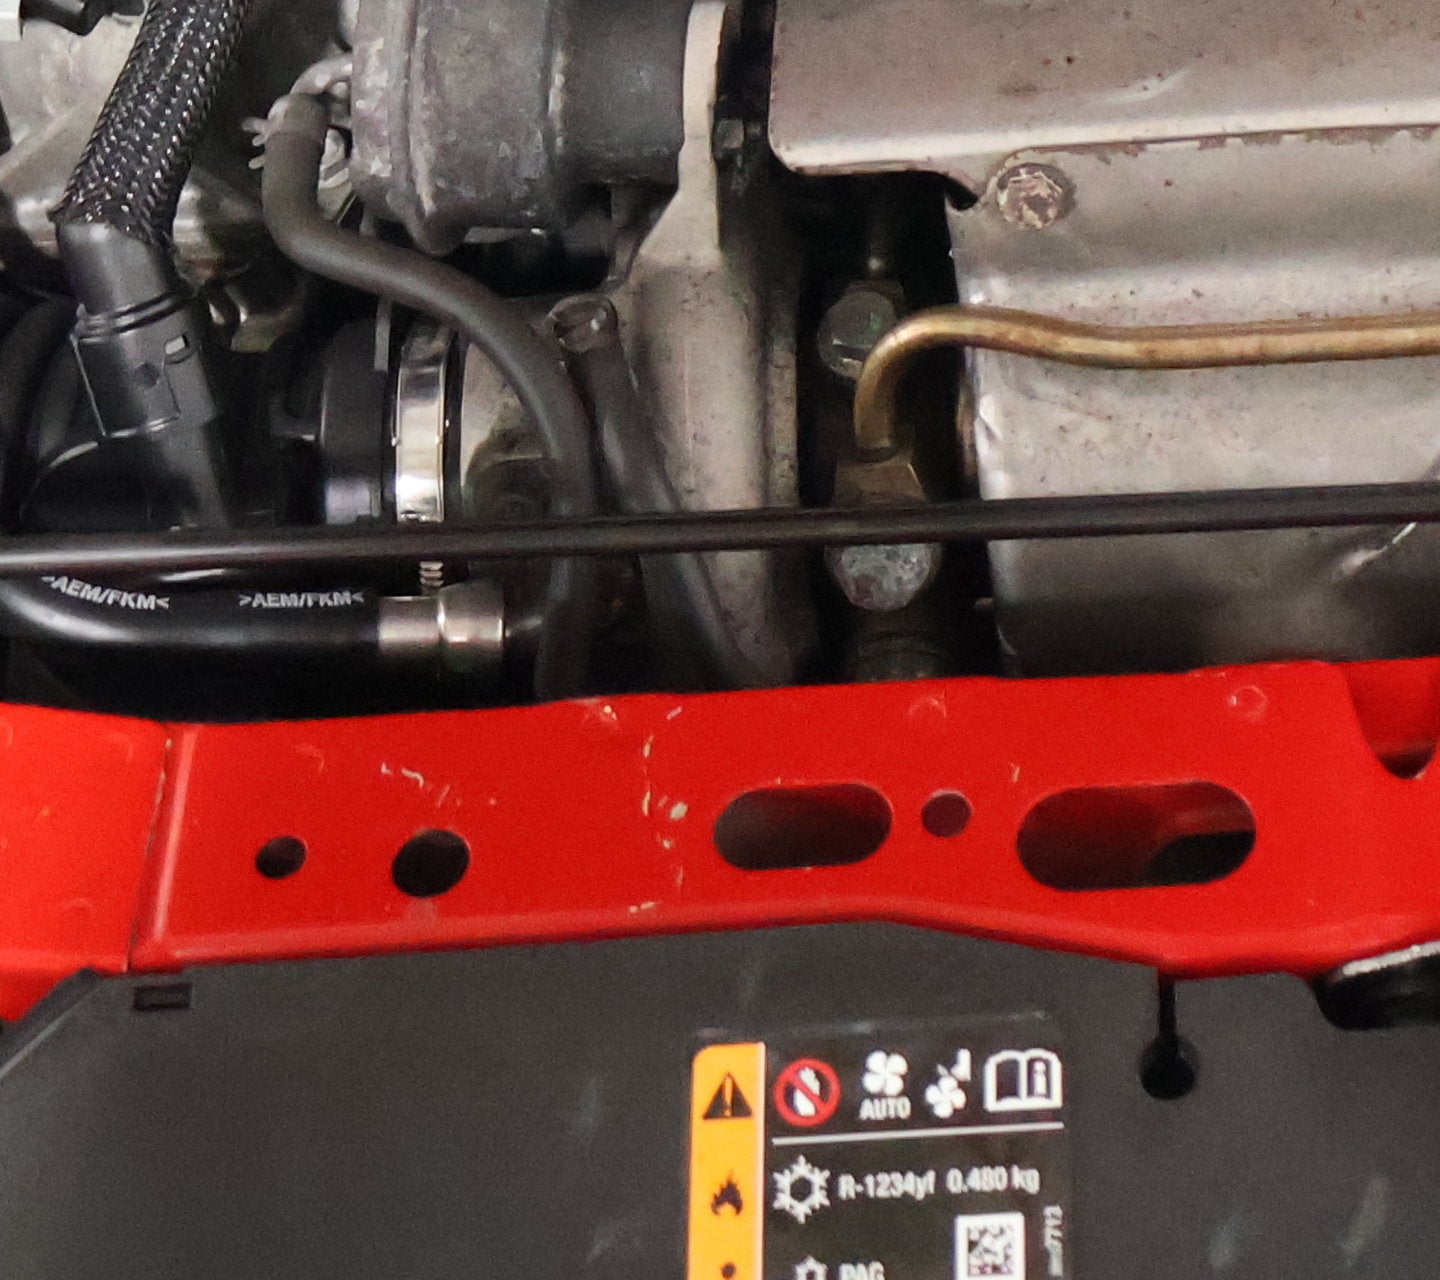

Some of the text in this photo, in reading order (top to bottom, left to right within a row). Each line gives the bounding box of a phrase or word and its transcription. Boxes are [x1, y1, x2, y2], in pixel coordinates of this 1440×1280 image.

[859, 1097, 912, 1121] AUTO
[839, 1169, 936, 1201] R-1234yf
[1011, 1164, 1040, 1195] kg
[839, 1261, 886, 1280] PAG
